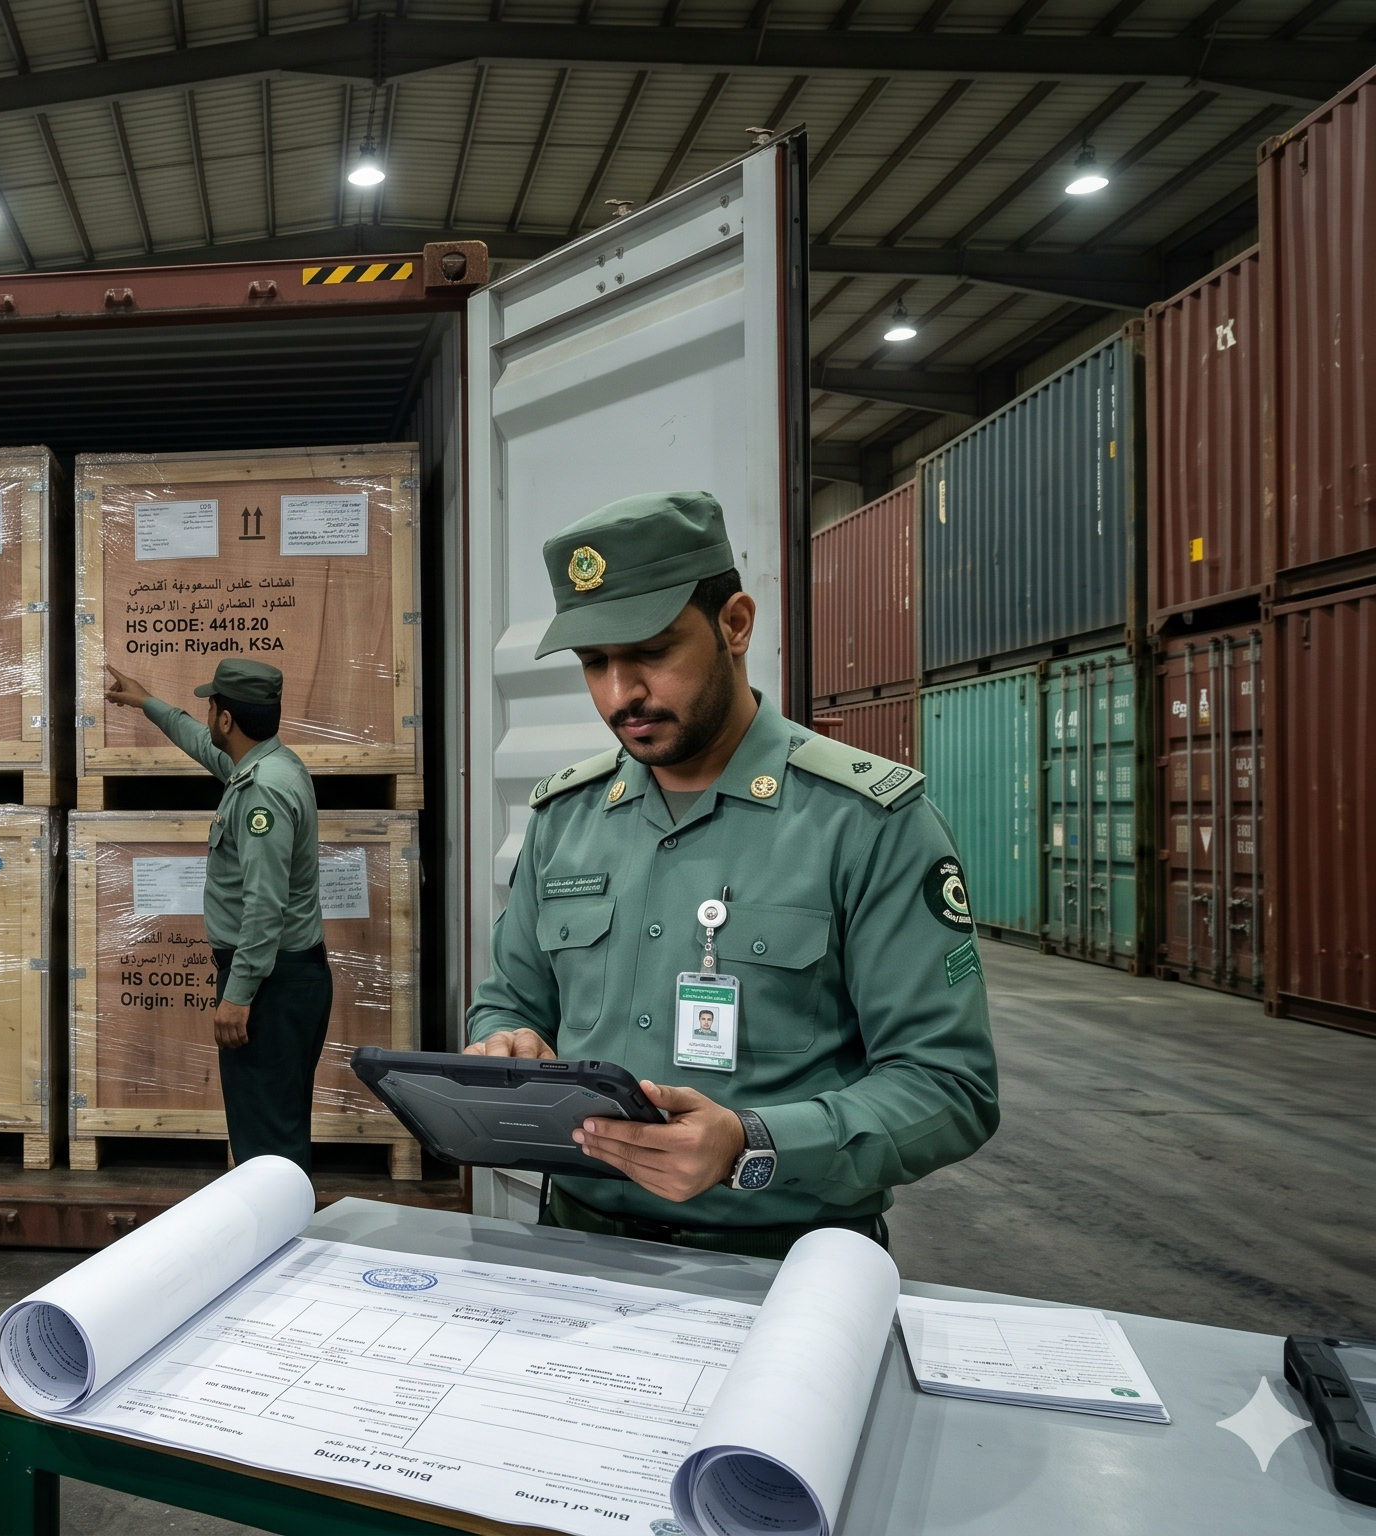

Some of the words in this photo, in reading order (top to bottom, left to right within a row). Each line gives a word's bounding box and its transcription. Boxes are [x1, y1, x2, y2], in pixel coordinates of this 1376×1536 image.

[126, 619, 148, 633] HS
[152, 618, 204, 633] CODE:
[209, 617, 269, 632] 4418.20
[126, 639, 179, 657] Origin:
[184, 638, 244, 655] Riyadh,
[249, 637, 285, 651] KSA
[121, 971, 143, 986] HS
[148, 972, 200, 988] CODE:
[120, 991, 174, 1011] Origin:
[184, 993, 217, 1012] Riya
[313, 1448, 371, 1468] Lading
[373, 1462, 392, 1471] of
[396, 1466, 433, 1482] Bills
[514, 1490, 569, 1508] Lading
[571, 1503, 589, 1511] of
[594, 1507, 631, 1522] Bills
